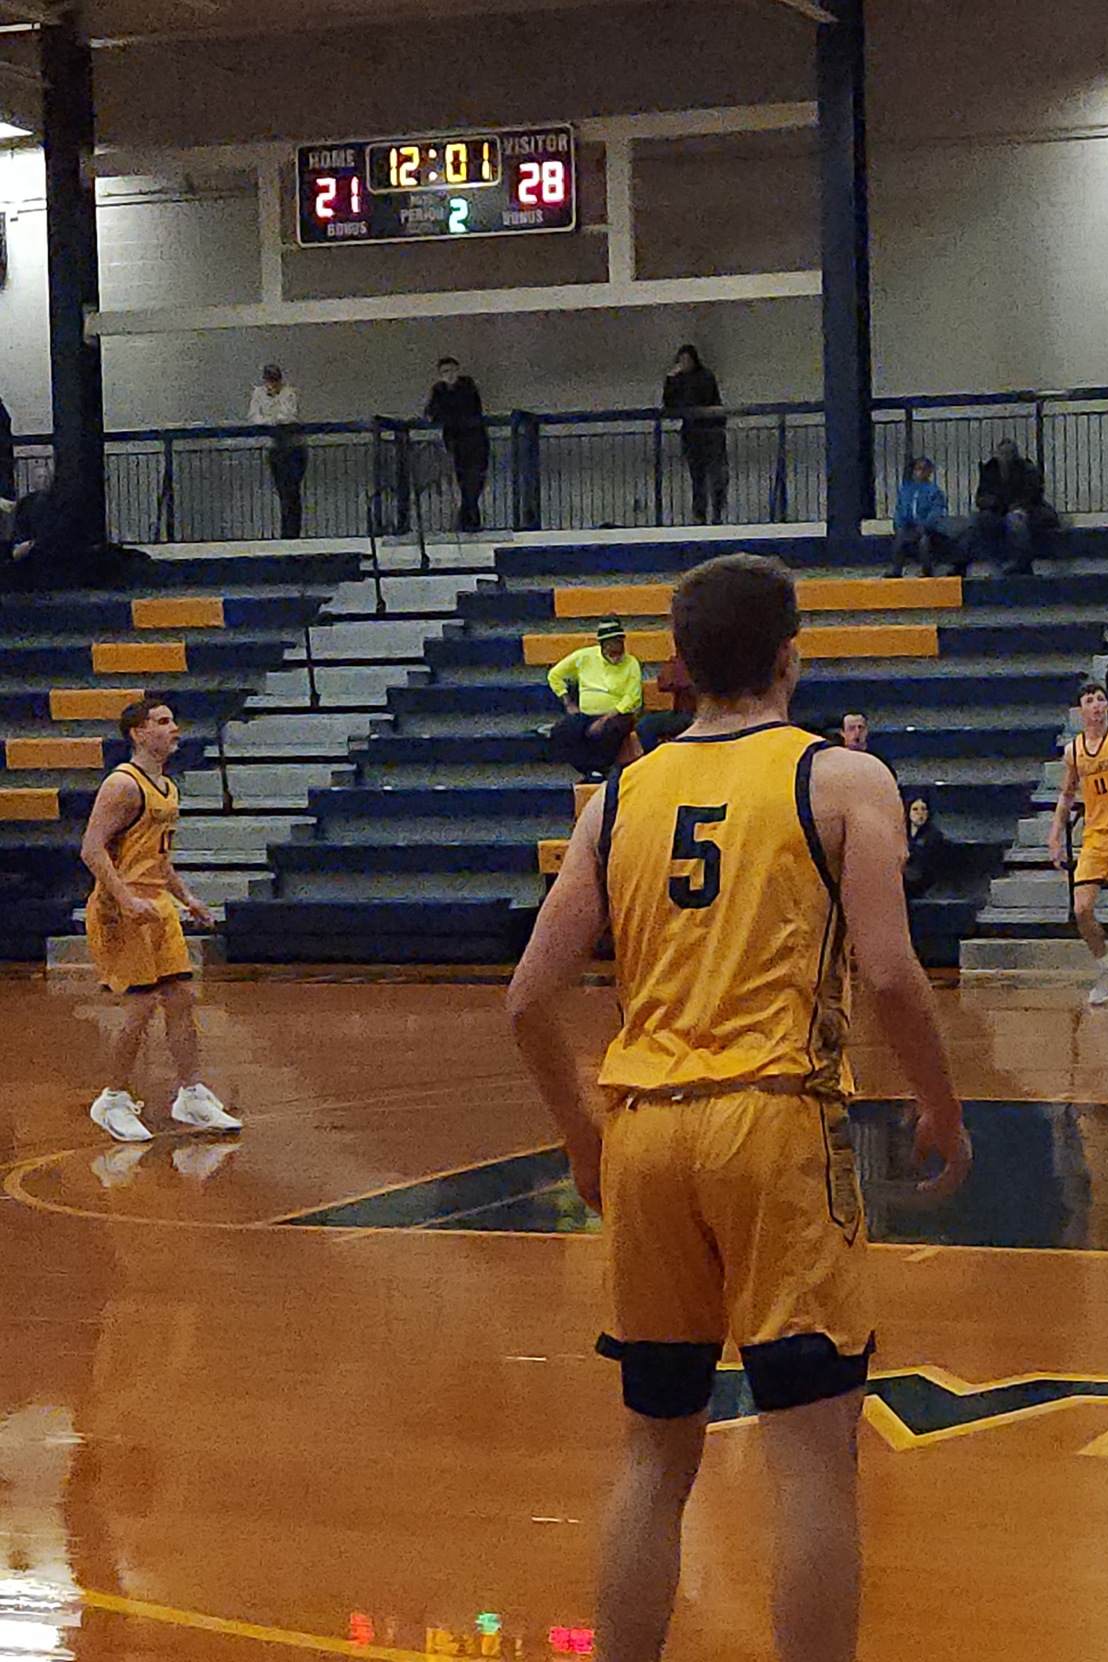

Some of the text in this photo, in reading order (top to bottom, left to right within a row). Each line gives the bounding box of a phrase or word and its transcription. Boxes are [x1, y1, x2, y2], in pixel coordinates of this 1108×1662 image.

[309, 149, 355, 169] HOME
[503, 133, 568, 155] VISITOR
[390, 142, 489, 186] 12:01
[518, 161, 564, 204] 28
[316, 176, 361, 218] 21
[449, 197, 468, 234] 2
[1094, 777, 1108, 796] 11
[668, 803, 728, 909] 5
